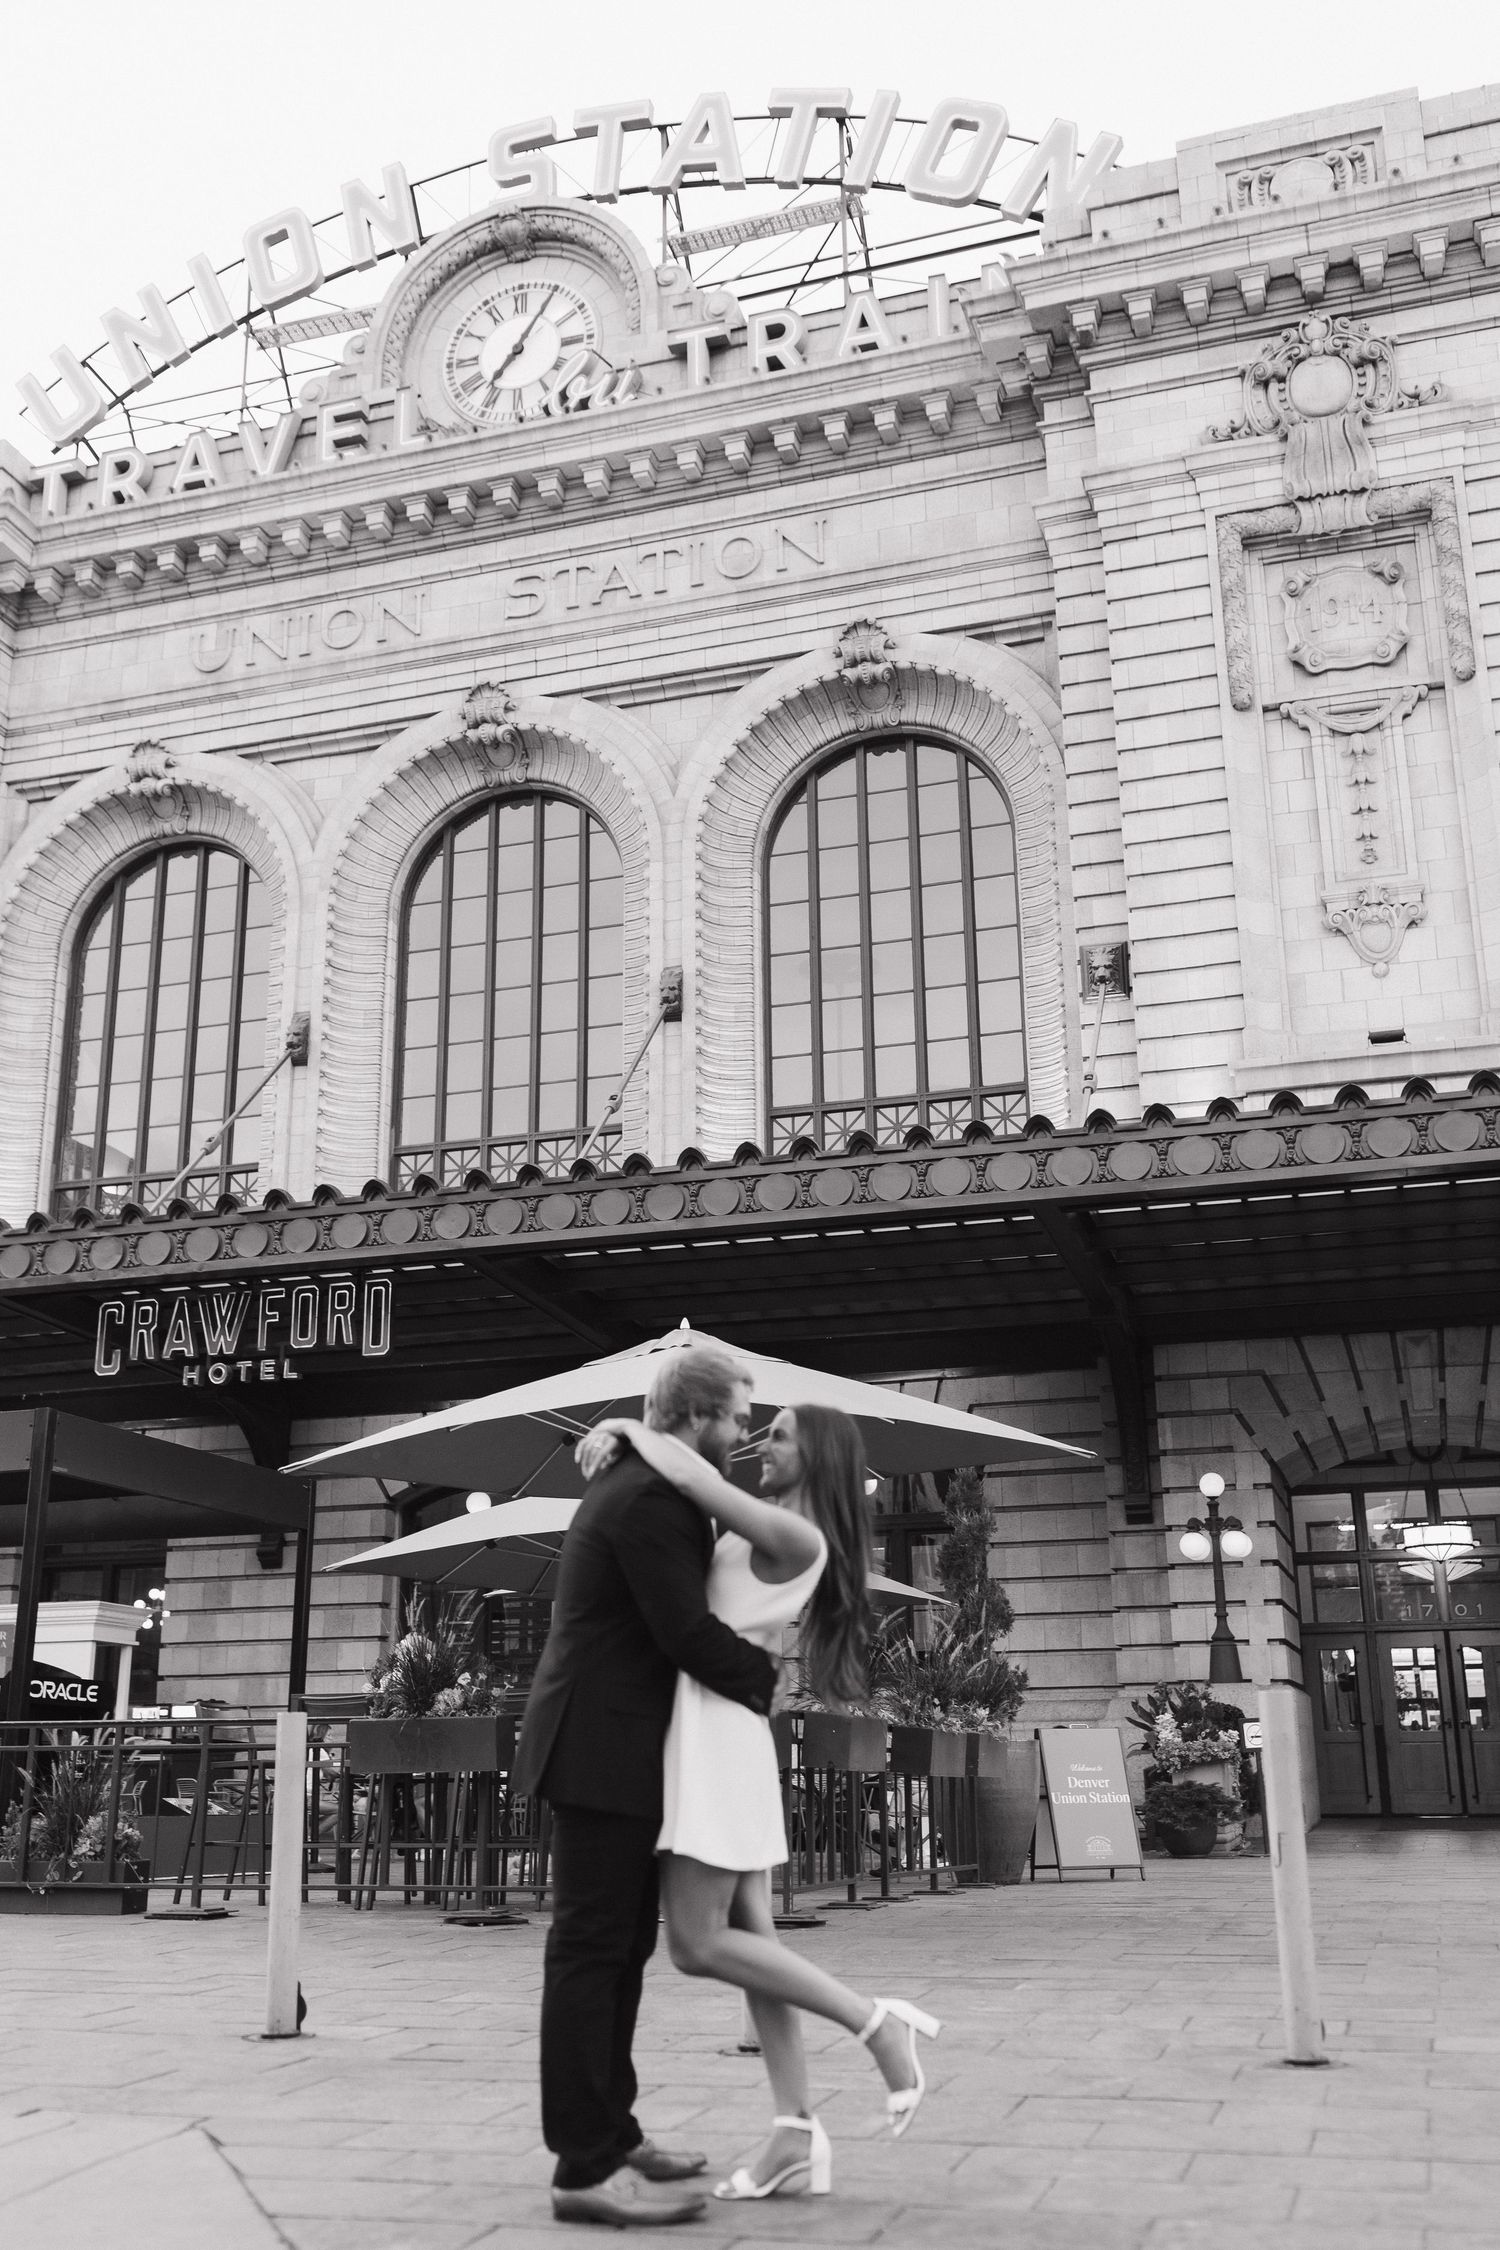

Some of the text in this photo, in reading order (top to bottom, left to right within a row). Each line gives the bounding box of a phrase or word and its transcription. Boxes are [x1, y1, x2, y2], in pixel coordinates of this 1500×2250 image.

[15, 87, 1125, 448] UNION STATION
[31, 386, 434, 518] TRAVEL
[188, 519, 828, 674] UNION STATION
[94, 1278, 392, 1376] CRAWFORD
[182, 1357, 299, 1387] HOTEL
[1050, 1791, 1131, 1804] Union Station
[1067, 1776, 1110, 1788] Denver
